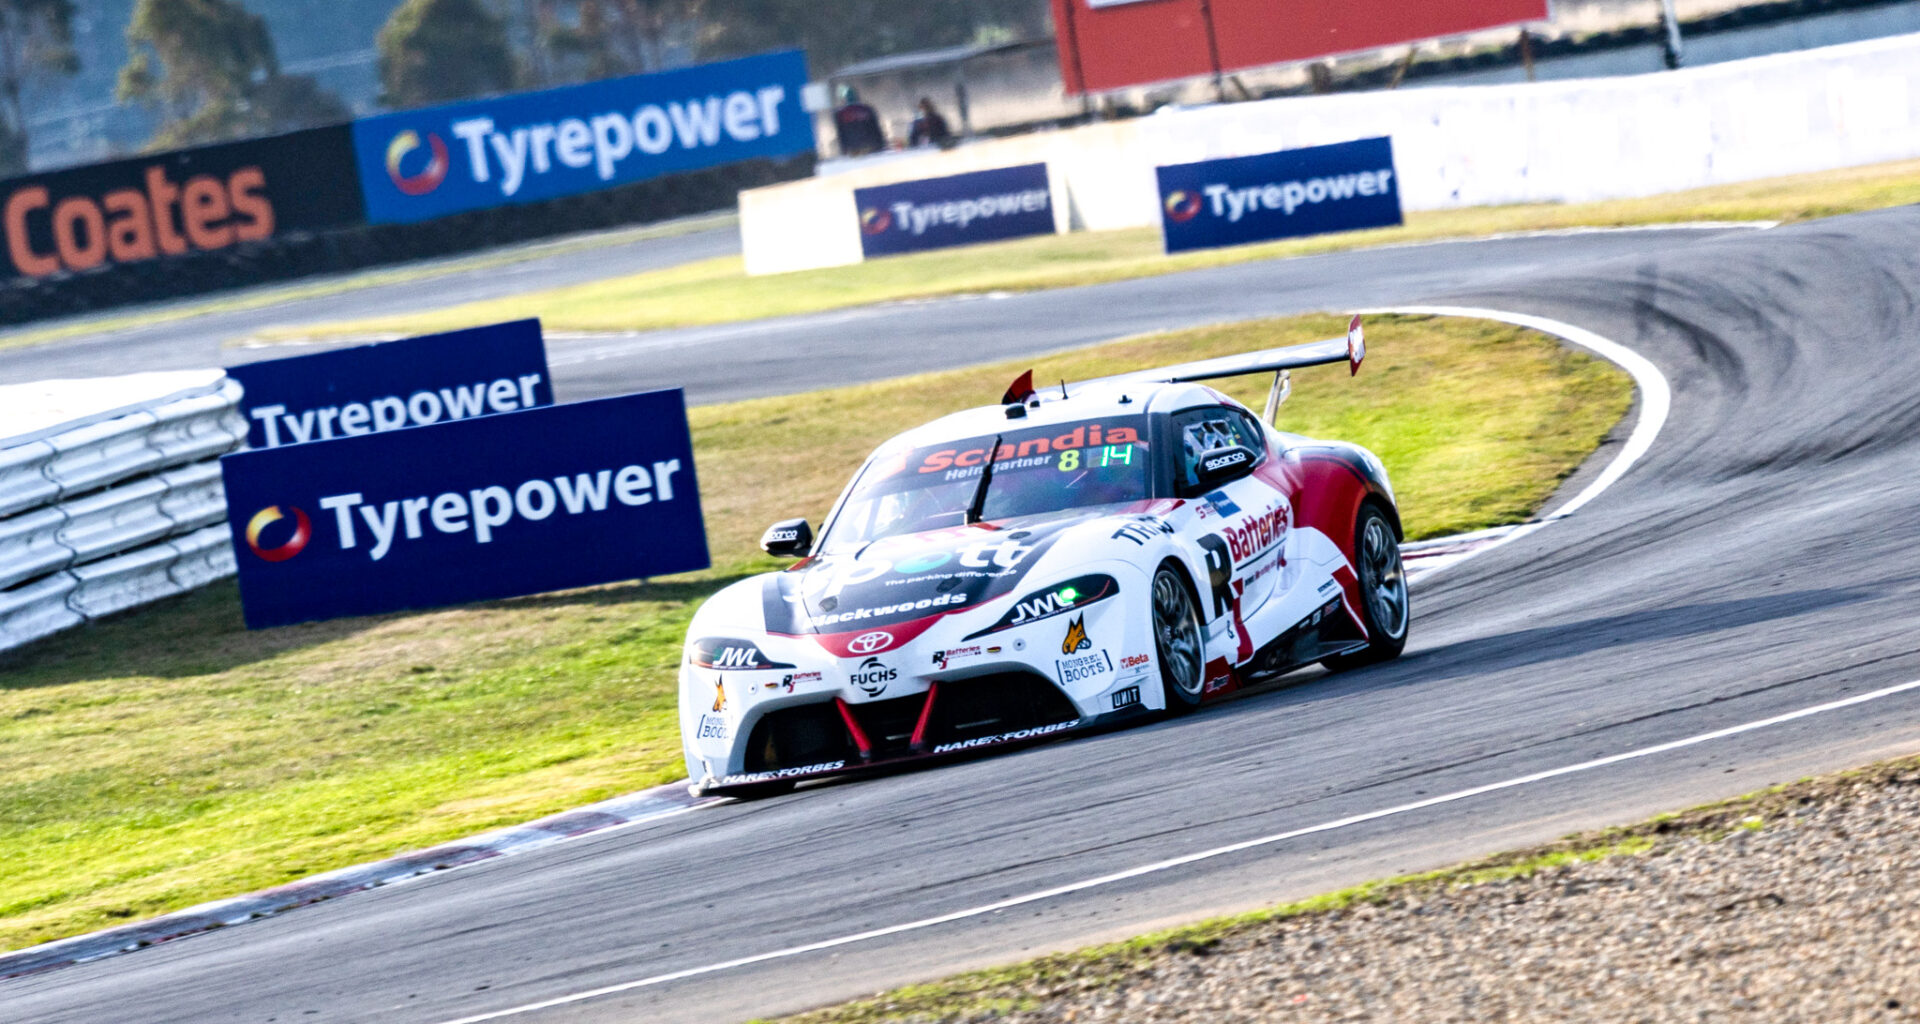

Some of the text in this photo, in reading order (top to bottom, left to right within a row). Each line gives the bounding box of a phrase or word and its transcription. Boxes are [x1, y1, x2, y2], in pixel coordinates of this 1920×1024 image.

[452, 84, 784, 197] Tyrepower
[1205, 168, 1391, 222] Tyrepower
[4, 165, 275, 277] Coates
[893, 189, 1049, 236] Tyrepower
[252, 374, 541, 448] Tyrepower
[918, 425, 1138, 473] Scandia
[1058, 449, 1080, 472] 8
[1101, 443, 1133, 468] 14
[1205, 452, 1246, 469] sparco
[320, 458, 681, 561] Tyrepower
[1222, 506, 1289, 564] Batteries
[885, 569, 1018, 587] The parking difference
[1011, 591, 1075, 624] JWL
[713, 647, 759, 666] JWL
[946, 646, 980, 656] Batteries
[1061, 654, 1102, 670] MONGREL
[1127, 653, 1149, 667] Beta
[850, 668, 897, 685] FUCHS
[1064, 662, 1105, 683] BOOTS
[1114, 688, 1138, 707] UNIT
